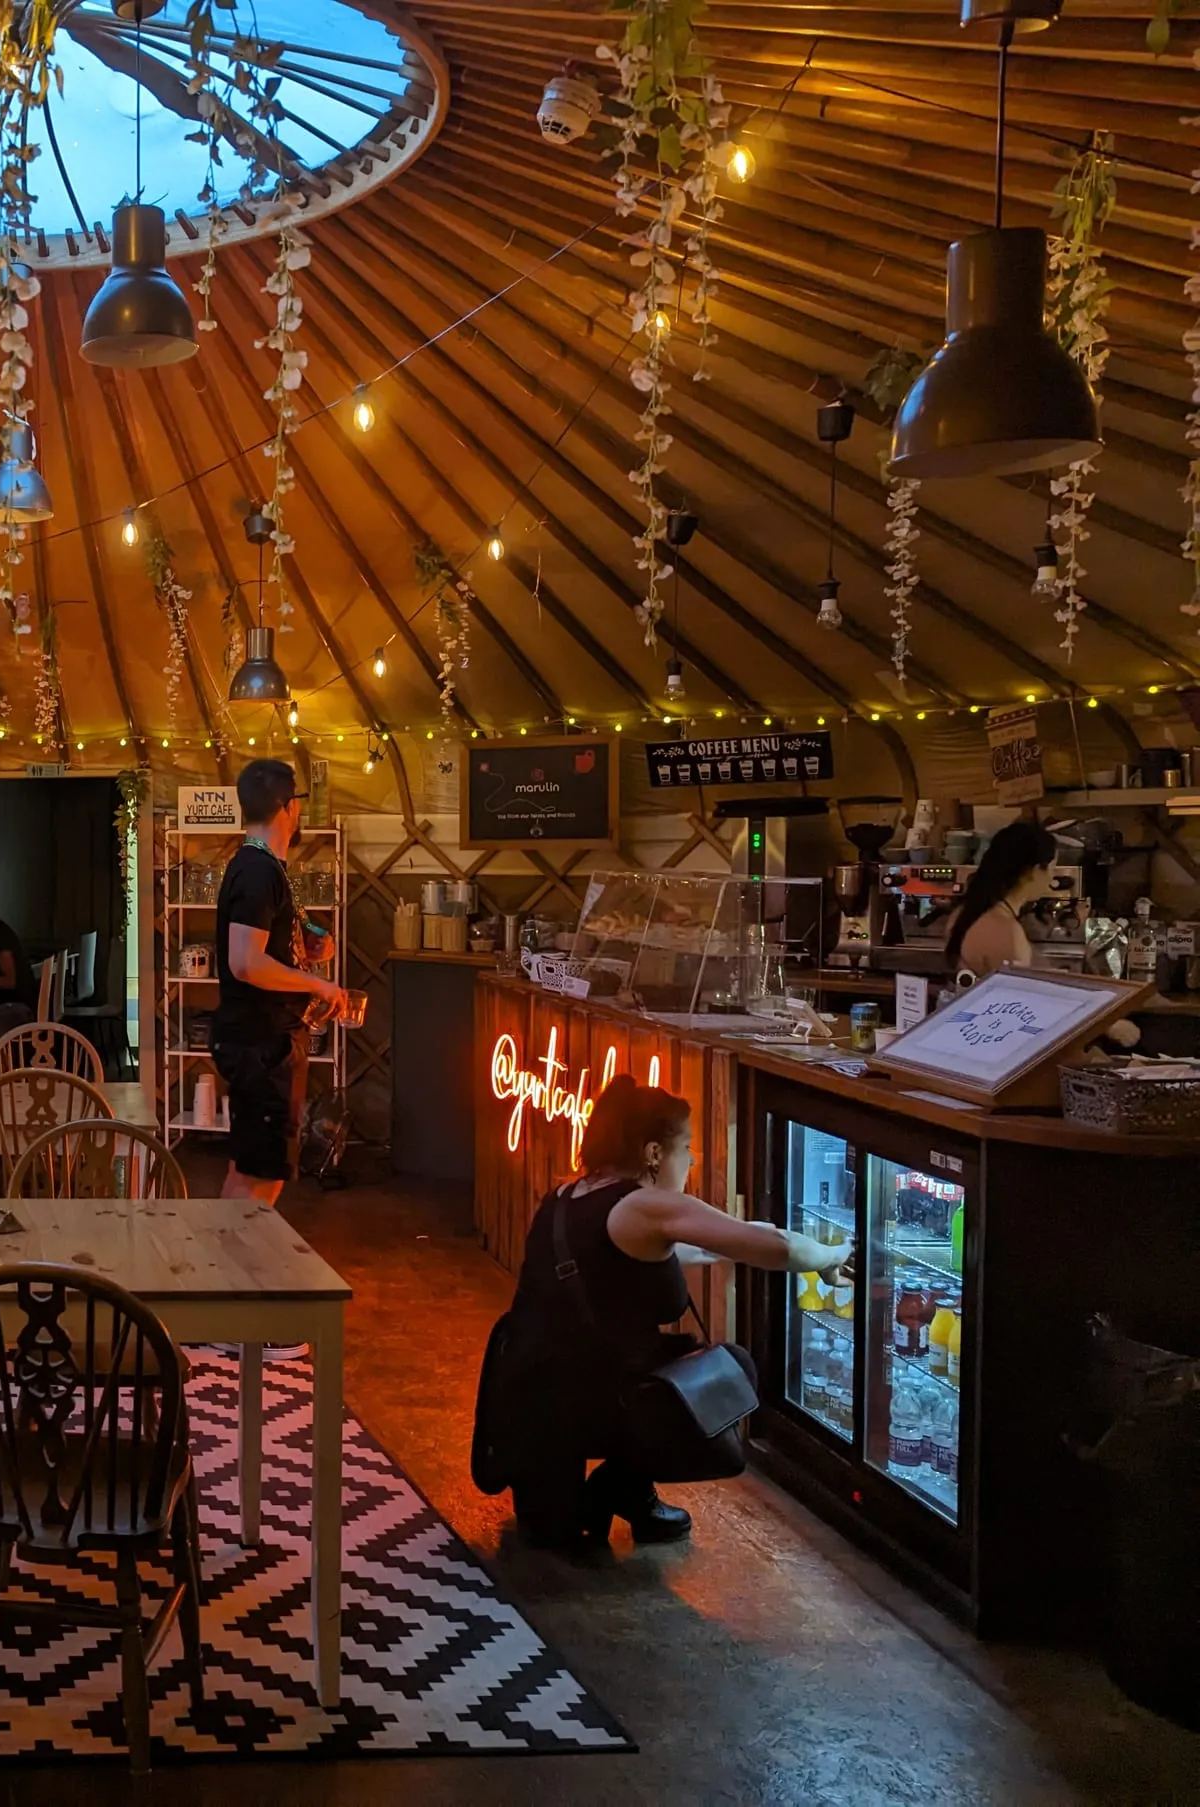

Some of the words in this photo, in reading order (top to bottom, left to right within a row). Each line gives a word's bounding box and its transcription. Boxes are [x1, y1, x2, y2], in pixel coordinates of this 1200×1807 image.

[688, 740, 739, 756] COFFEE
[741, 737, 780, 753] MENU
[515, 782, 560, 793] marulin
[194, 792, 225, 802] NTN
[187, 804, 208, 815] YURT
[210, 804, 233, 815] CAFE
[988, 1018, 1002, 1029] is
